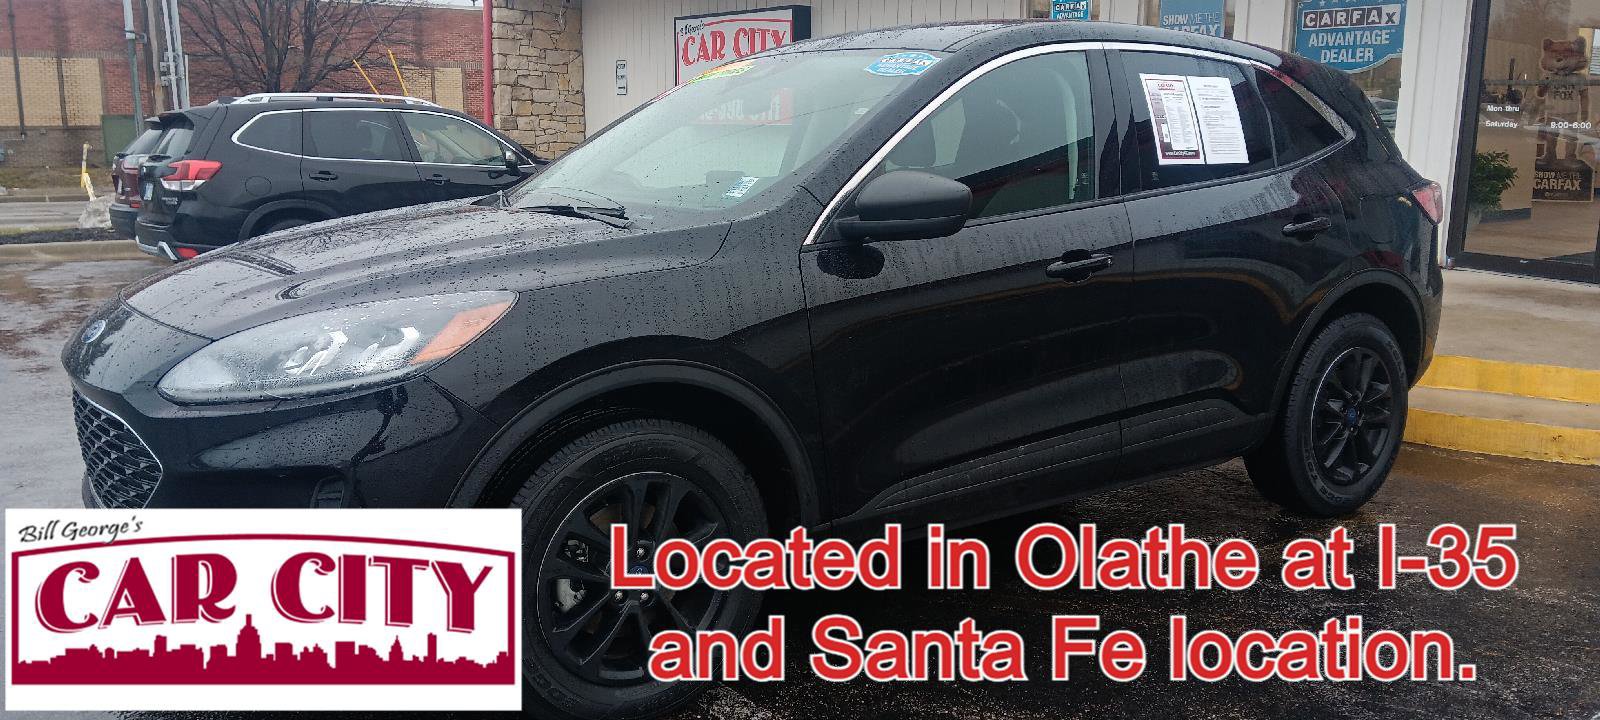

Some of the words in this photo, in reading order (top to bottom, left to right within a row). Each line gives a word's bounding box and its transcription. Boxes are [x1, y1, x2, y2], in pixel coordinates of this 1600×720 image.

[1055, 1, 1087, 11] CARFAX
[1163, 14, 1188, 26] SHOW
[1190, 13, 1203, 24] ME
[1203, 12, 1220, 23] THE
[1304, 7, 1398, 27] CARFAX
[1308, 29, 1390, 47] ADVANTAGE
[682, 30, 726, 66] CAR
[733, 27, 787, 58] CITY
[1320, 47, 1374, 63] DEALER
[1486, 104, 1503, 112] Mon
[1505, 104, 1520, 112] thru
[1485, 120, 1518, 129] Saturday
[1535, 171, 1555, 179] SHOW
[1535, 179, 1581, 190] CARFAX
